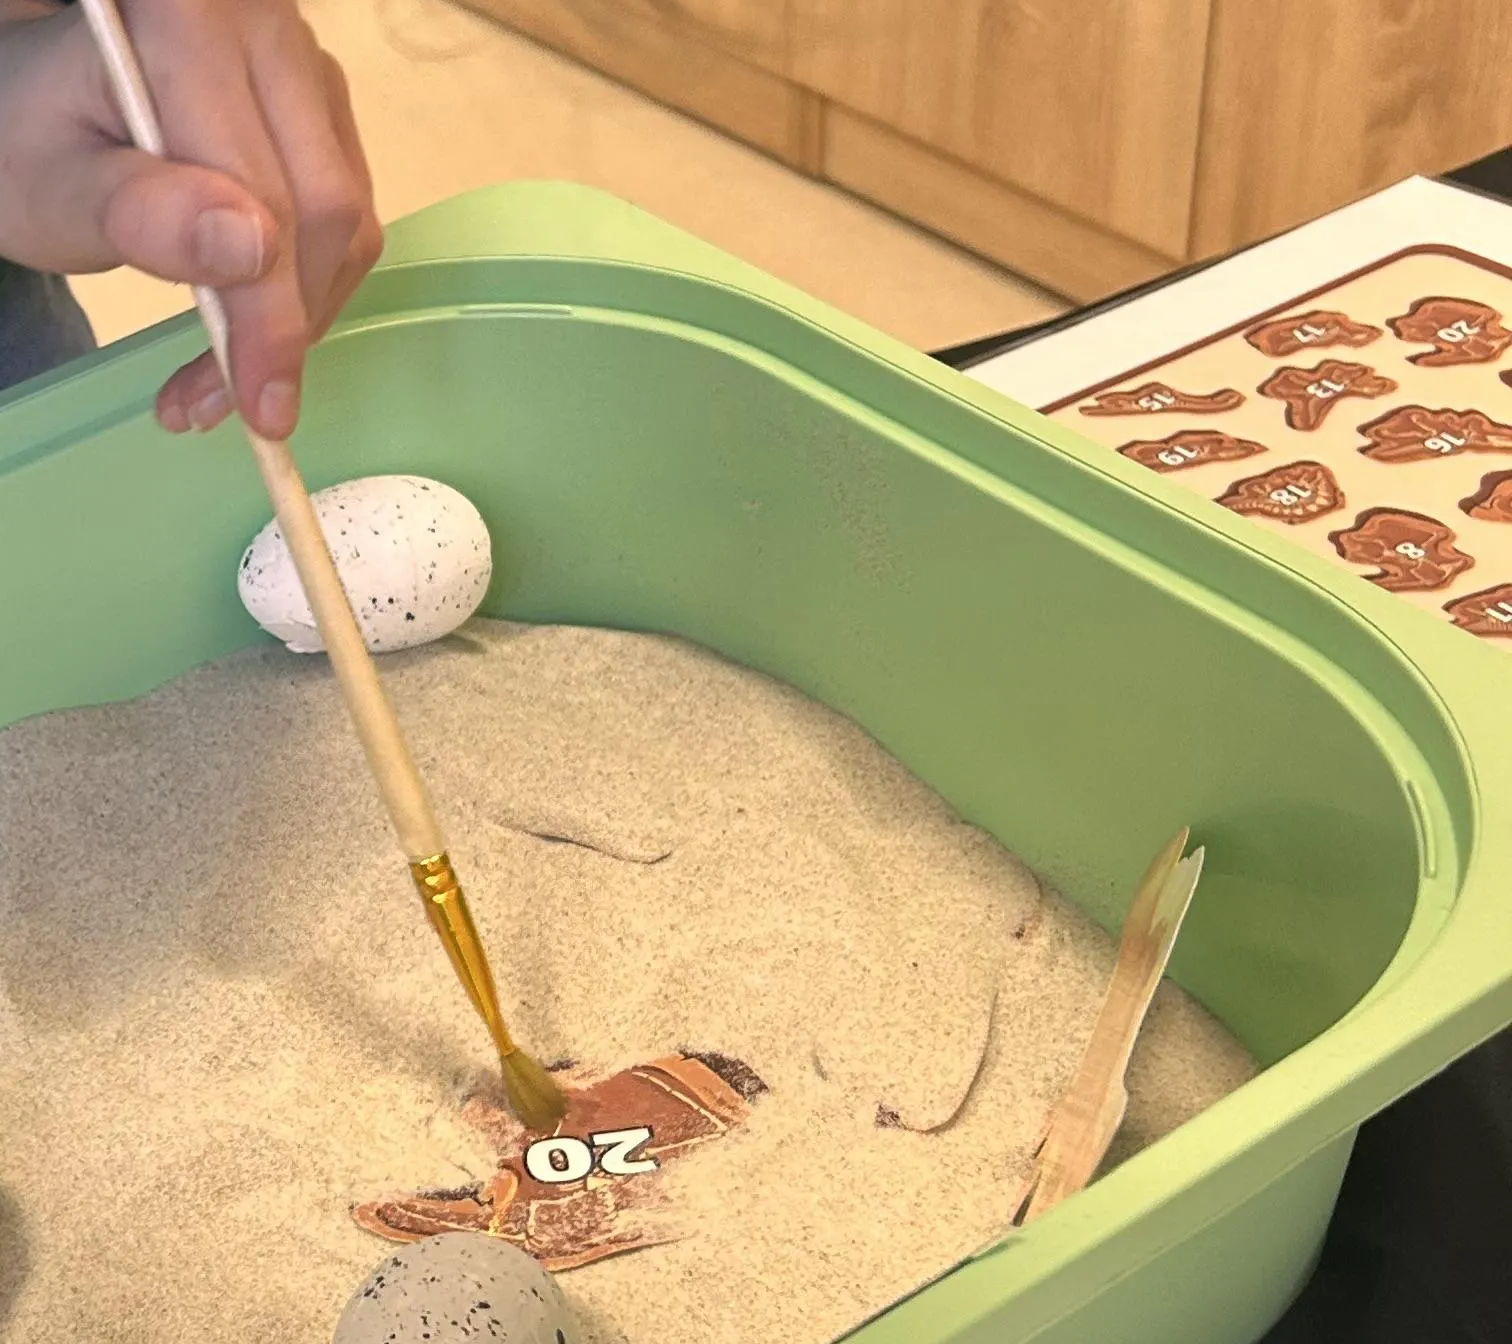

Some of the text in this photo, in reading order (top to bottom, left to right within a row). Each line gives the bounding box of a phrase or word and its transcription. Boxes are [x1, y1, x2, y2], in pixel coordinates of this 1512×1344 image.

[1292, 323, 1326, 344] 17
[1436, 319, 1481, 343] 20
[1305, 379, 1346, 399] 13
[1138, 392, 1176, 411] 15
[1423, 431, 1466, 454] 16
[1157, 445, 1199, 466] 19
[1269, 483, 1312, 506] 18
[1394, 541, 1426, 560] 8
[525, 1124, 660, 1185] 20
